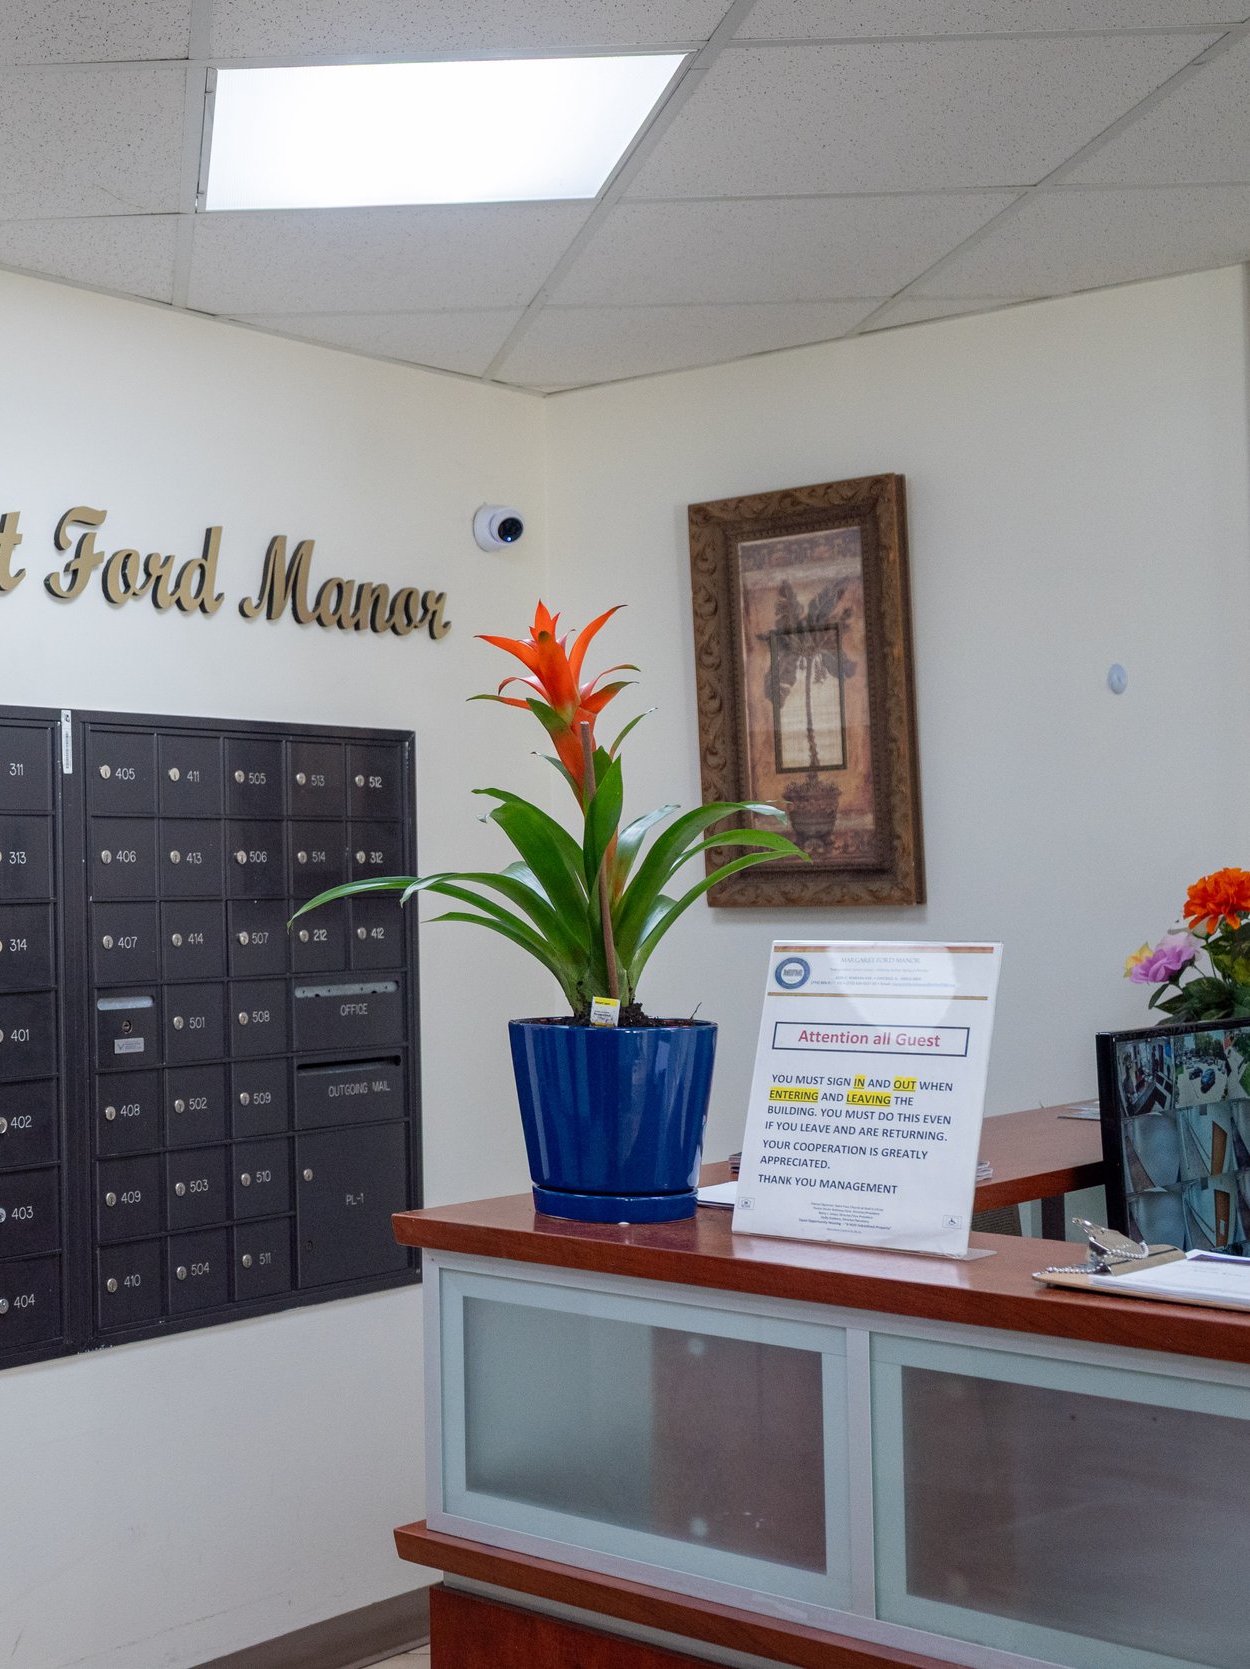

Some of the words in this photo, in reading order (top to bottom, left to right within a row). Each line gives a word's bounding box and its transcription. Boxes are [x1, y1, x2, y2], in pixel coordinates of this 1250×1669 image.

[44, 506, 224, 613] Ford
[238, 535, 451, 640] Manor
[10, 763, 23, 775] 311
[116, 768, 135, 780] 405
[187, 771, 199, 782] 411
[249, 773, 266, 784] 505
[312, 775, 324, 786] 513
[369, 776, 382, 787] 512
[10, 852, 26, 864] 313
[117, 851, 136, 862] 406
[187, 853, 202, 864] 413
[250, 851, 267, 862] 506
[313, 852, 325, 862] 514
[370, 852, 382, 863] 312
[188, 933, 203, 944] 414
[252, 932, 268, 944] 507
[314, 929, 327, 941] 212
[371, 928, 384, 938] 412
[10, 939, 27, 951] 314
[118, 937, 137, 948] 407
[341, 1003, 367, 1016] OFFICE
[190, 1017, 204, 1028] 501
[253, 1011, 270, 1022] 508
[11, 1029, 29, 1041] 401
[798, 1030, 868, 1044] Attention
[873, 1032, 890, 1045] all
[896, 1033, 940, 1047] Guest
[772, 1074, 793, 1083] YOU
[795, 1076, 825, 1084] MUST
[827, 1077, 851, 1086] SIGN
[854, 1078, 865, 1087] IN
[868, 1079, 891, 1088] AND
[894, 1080, 916, 1089] OUT
[919, 1081, 953, 1091] WHEN
[329, 1082, 368, 1097] OUTGOING
[373, 1081, 390, 1091] MAIL
[189, 1098, 207, 1110] 502
[254, 1092, 271, 1104] 509
[769, 1090, 819, 1100] ENTERING
[821, 1092, 844, 1102] AND
[846, 1094, 891, 1104] LEAVING
[894, 1096, 913, 1106] THE
[121, 1104, 140, 1116] 408
[768, 1106, 817, 1116] BUILDING.
[821, 1108, 842, 1118] YOU
[845, 1110, 875, 1120] MUST
[878, 1112, 894, 1121] DO
[897, 1113, 920, 1123] THIS
[923, 1115, 951, 1124] EVEN
[11, 1115, 31, 1128] 402
[765, 1121, 774, 1129] IF
[776, 1122, 797, 1131] YOU
[800, 1124, 830, 1133] LEAVE
[833, 1126, 856, 1135] AND
[858, 1127, 879, 1136] ARE
[882, 1129, 947, 1141] RETURNING.
[763, 1140, 791, 1149] YOUR
[793, 1142, 866, 1155] COOPERATION
[869, 1147, 878, 1156] IS
[881, 1148, 928, 1160] GREATLY
[760, 1156, 830, 1169] APPRECIATED.
[257, 1171, 271, 1183] 510
[190, 1179, 208, 1192] 503
[758, 1174, 792, 1185] THANK
[795, 1177, 817, 1187] YOU
[819, 1179, 898, 1194] MANAGEMENT
[121, 1191, 141, 1203] 409
[346, 1193, 363, 1205] PL-1
[12, 1206, 33, 1219] 403
[260, 1253, 271, 1264] 511
[192, 1262, 209, 1275] 504
[124, 1274, 140, 1287] 410
[14, 1294, 35, 1308] 404
